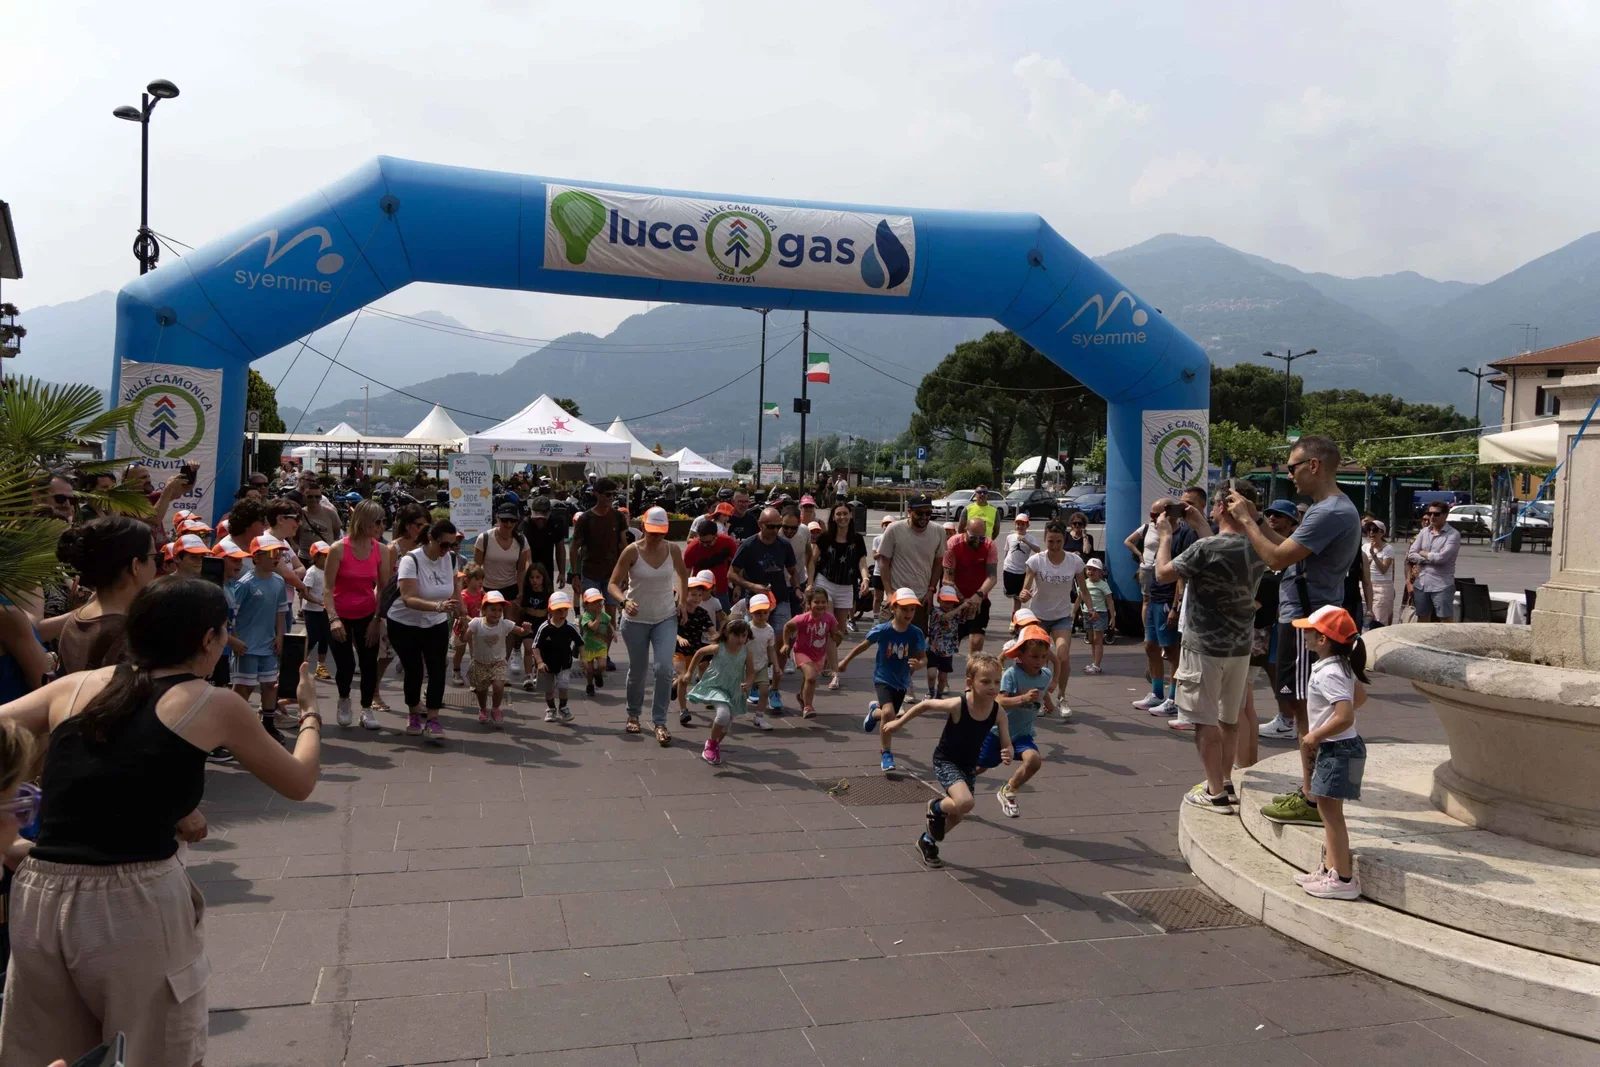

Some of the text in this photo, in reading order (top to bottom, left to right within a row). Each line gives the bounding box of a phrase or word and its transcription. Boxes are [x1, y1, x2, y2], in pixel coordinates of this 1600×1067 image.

[699, 203, 778, 232] VALLE CAMONICA
[608, 208, 856, 268] luce gas
[711, 256, 736, 275] VENDITE
[234, 269, 332, 294] syemme
[716, 272, 756, 285] SERVIZI
[1072, 331, 1147, 348] syemme
[124, 374, 213, 412] VALLE CAMONICA
[1149, 423, 1174, 446] VALLE
[918, 447, 925, 459] P
[140, 456, 187, 470] SERVIZI
[455, 470, 487, 478] sportiva
[460, 476, 482, 485] MENTE
[172, 501, 198, 510] casa
